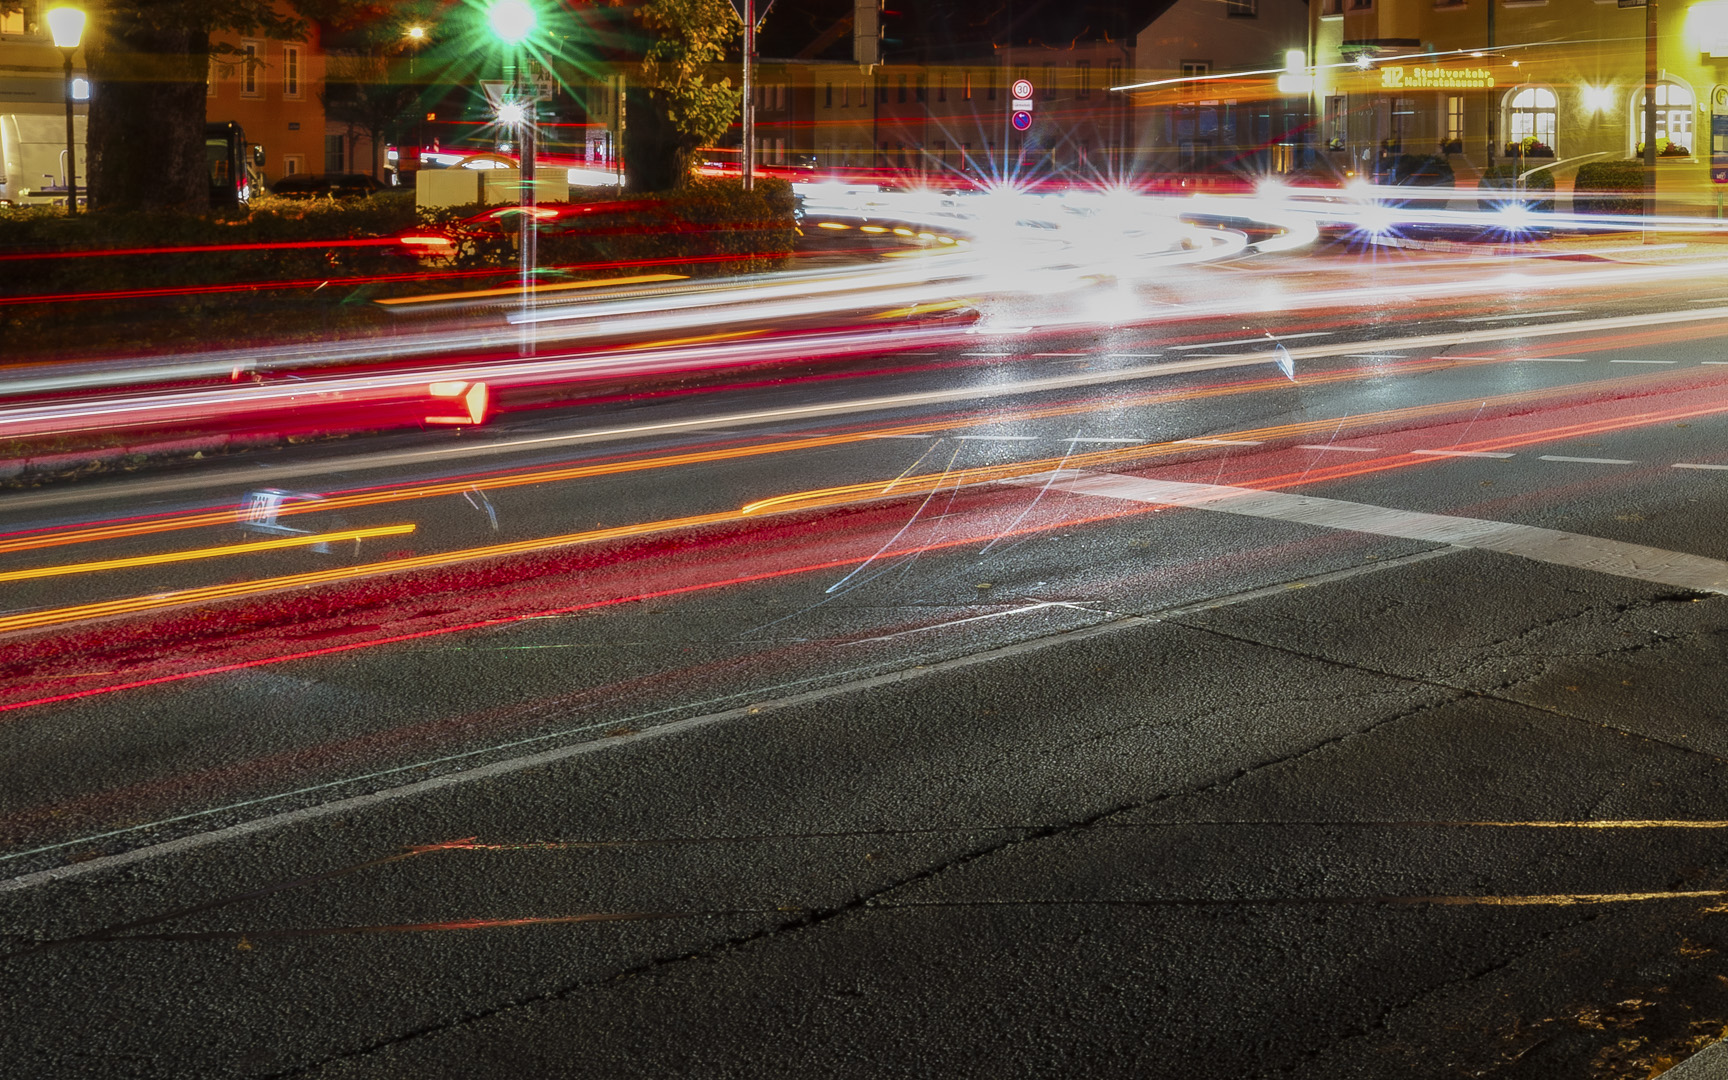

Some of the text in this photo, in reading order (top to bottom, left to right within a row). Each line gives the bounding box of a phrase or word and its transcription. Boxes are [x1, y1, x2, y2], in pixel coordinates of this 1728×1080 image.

[1413, 68, 1490, 79] Stadtverkehr
[1405, 76, 1485, 88] Wolfratshausen
[1017, 85, 1029, 95] 30
